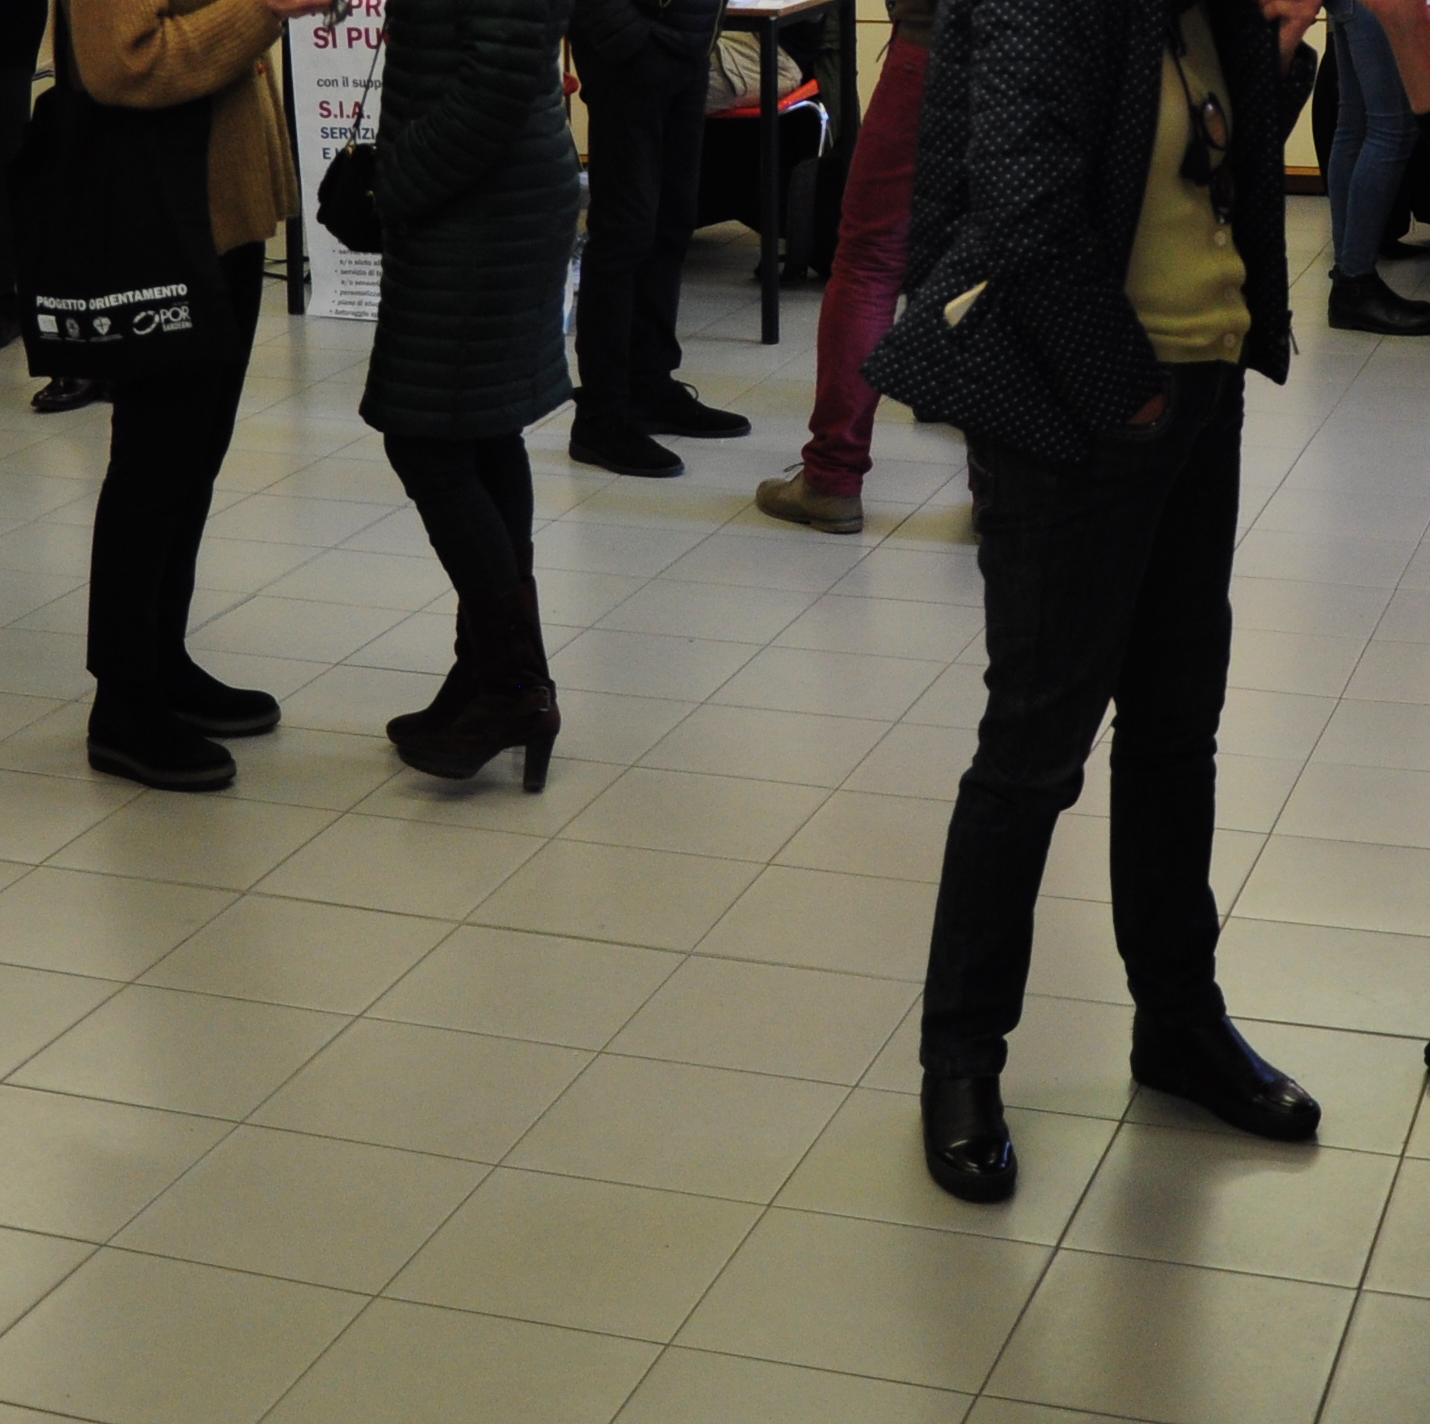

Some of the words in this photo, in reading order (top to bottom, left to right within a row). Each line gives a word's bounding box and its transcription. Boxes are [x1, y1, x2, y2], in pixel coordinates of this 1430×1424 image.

[313, 27, 338, 49] SI
[347, 27, 389, 50] PU
[317, 78, 339, 88] con
[342, 76, 349, 88] il
[318, 100, 371, 119] S.I.A.
[89, 283, 188, 311] ORIENTAMENTO
[160, 306, 190, 323] POR
